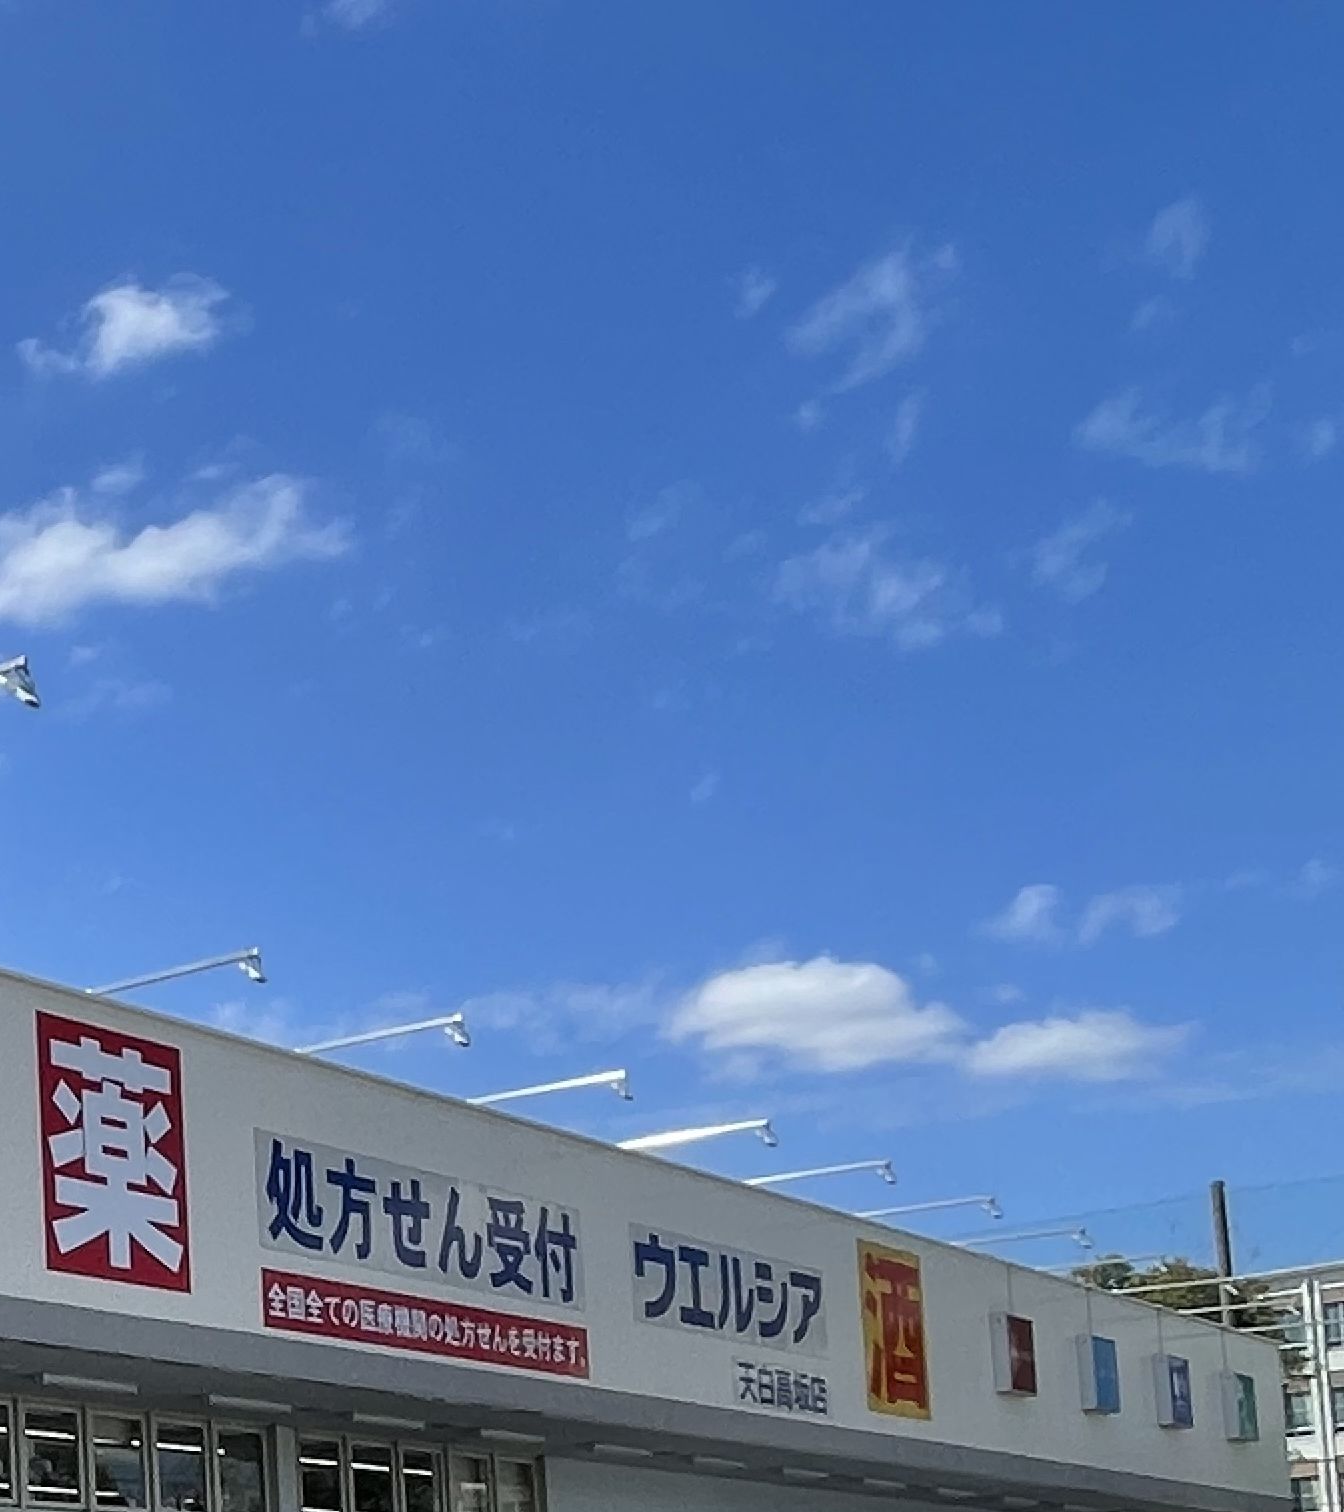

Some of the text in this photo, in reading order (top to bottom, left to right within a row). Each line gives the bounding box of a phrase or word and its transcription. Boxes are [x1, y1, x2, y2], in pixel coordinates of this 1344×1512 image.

[48, 1036, 184, 1273] 薬
[265, 1138, 577, 1303] 処方せん受付
[632, 1232, 823, 1344] ウエルシア
[864, 1251, 926, 1409] 酒
